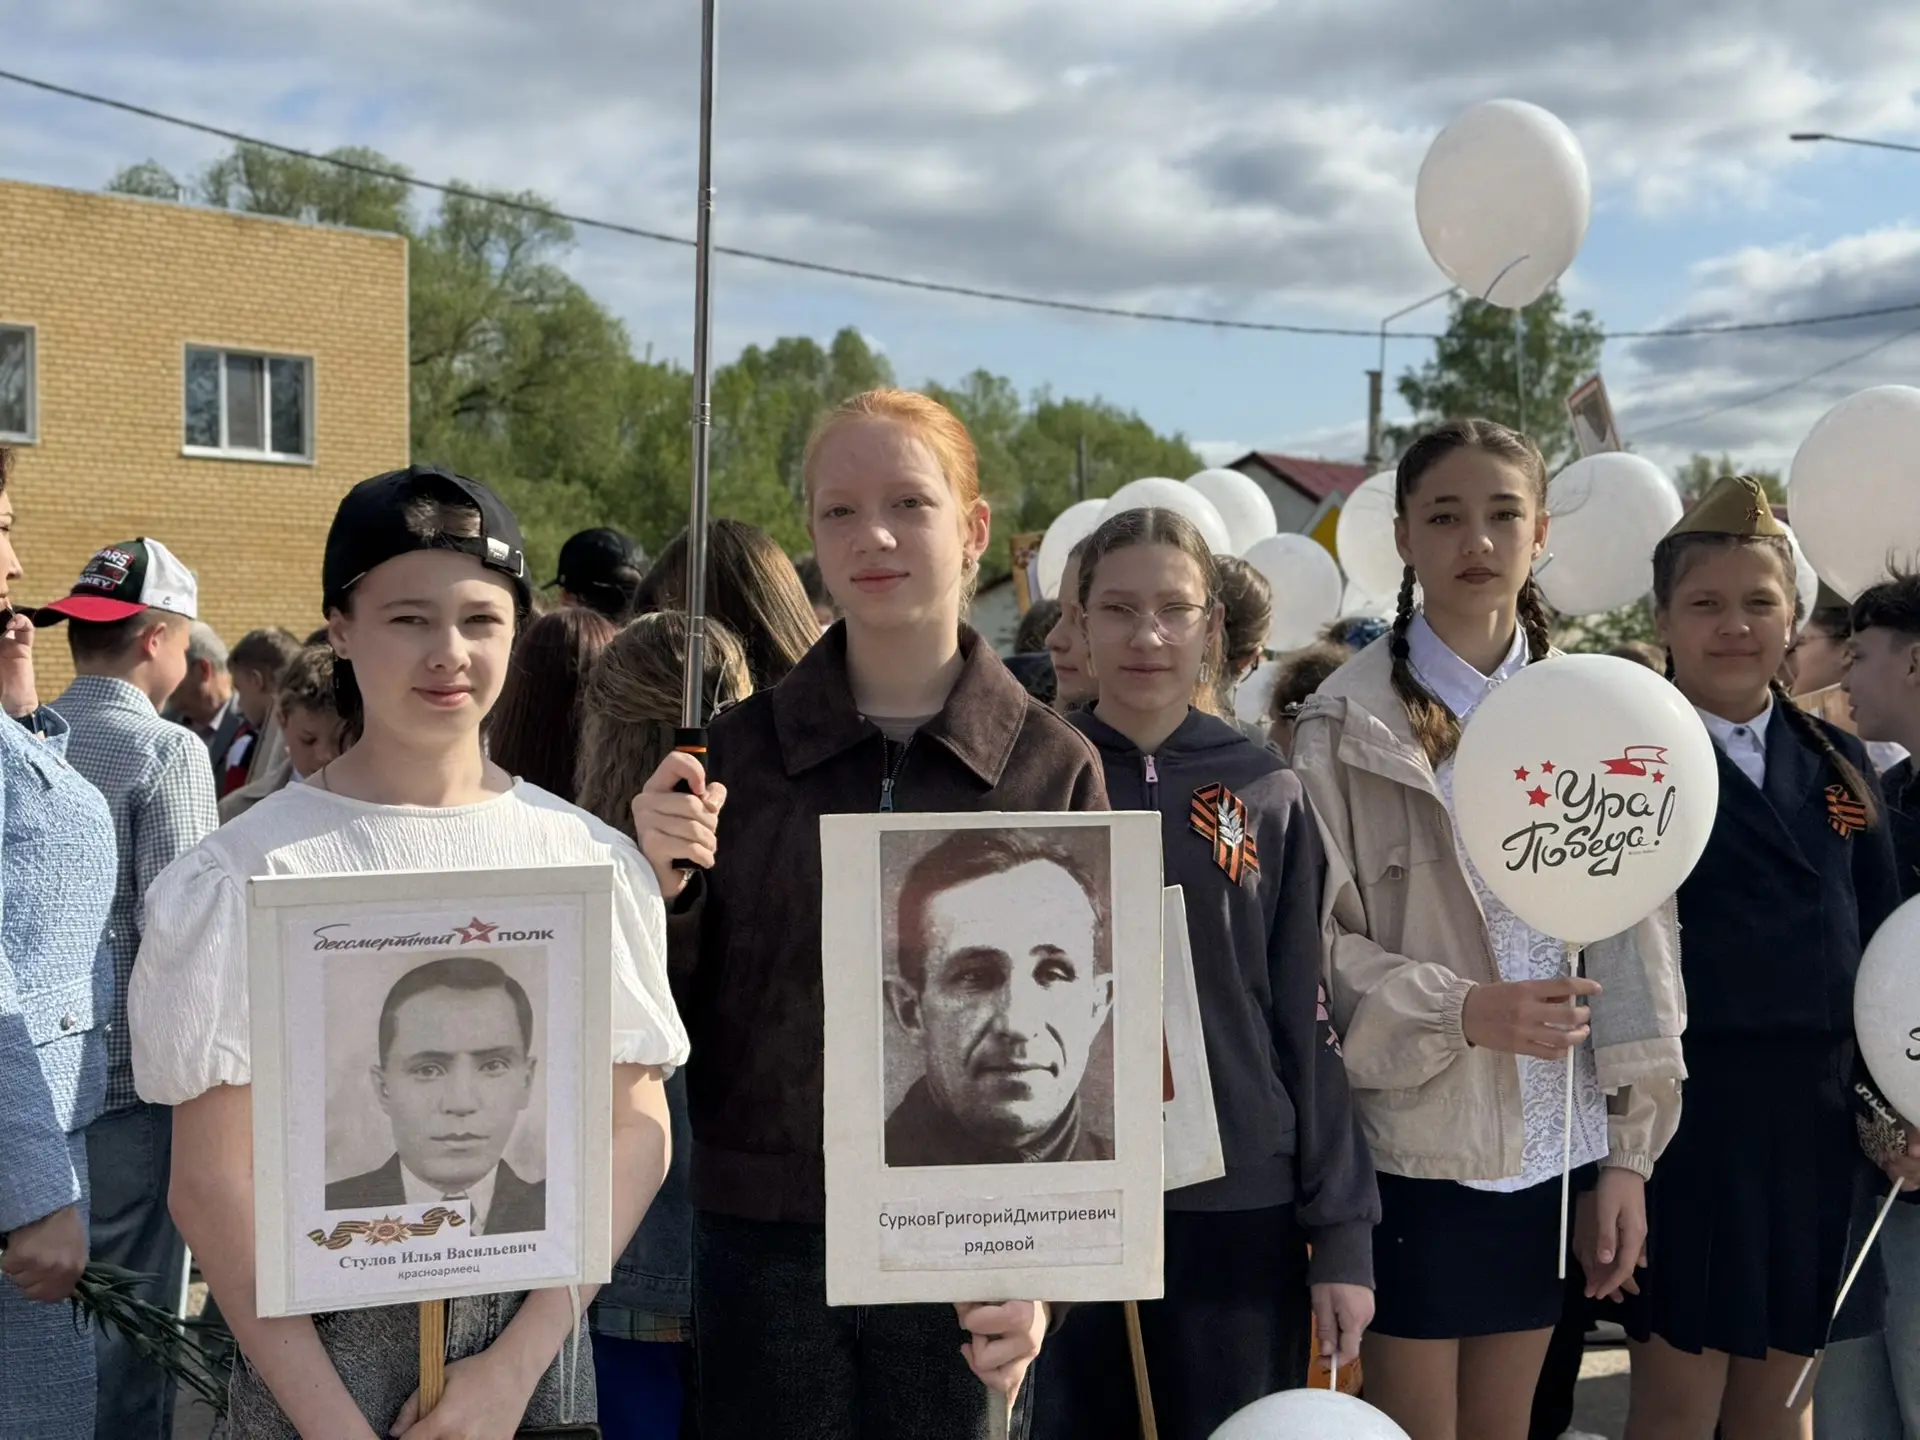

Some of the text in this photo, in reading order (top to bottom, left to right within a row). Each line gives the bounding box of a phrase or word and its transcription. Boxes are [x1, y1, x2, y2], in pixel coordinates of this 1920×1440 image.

[879, 1208, 1116, 1229] СурковГригорийДмитриевич
[964, 1236, 1034, 1255] рядовой
[339, 1243, 537, 1271] Стулов Илья Васильевич
[398, 1264, 481, 1280] красноармеец
